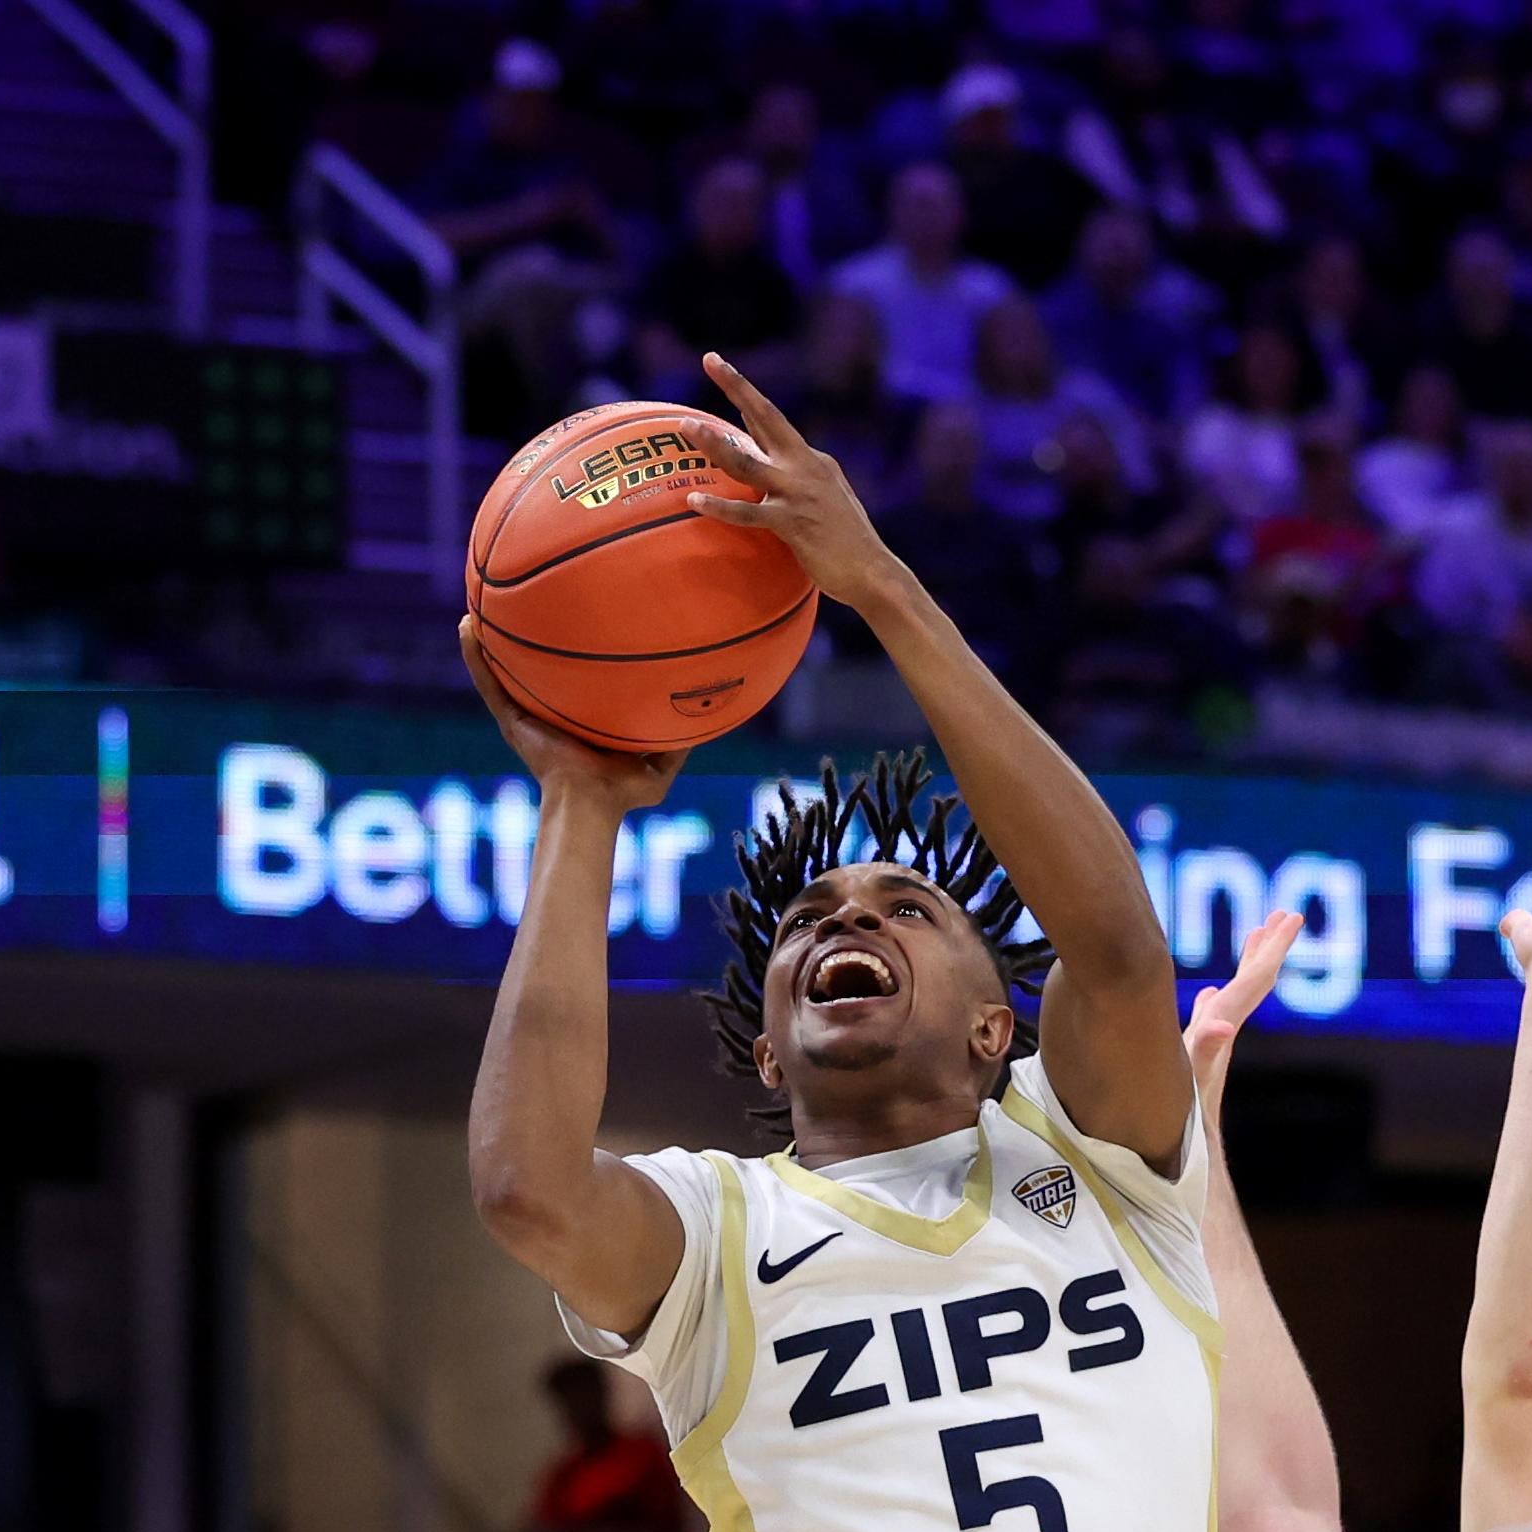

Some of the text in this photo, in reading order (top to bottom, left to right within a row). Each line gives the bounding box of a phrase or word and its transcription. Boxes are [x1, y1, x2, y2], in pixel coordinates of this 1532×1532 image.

[550, 431, 699, 503] LEGA
[622, 457, 723, 489] 100
[1023, 1178, 1076, 1212] MAC
[773, 1269, 1145, 1428] ZIPS
